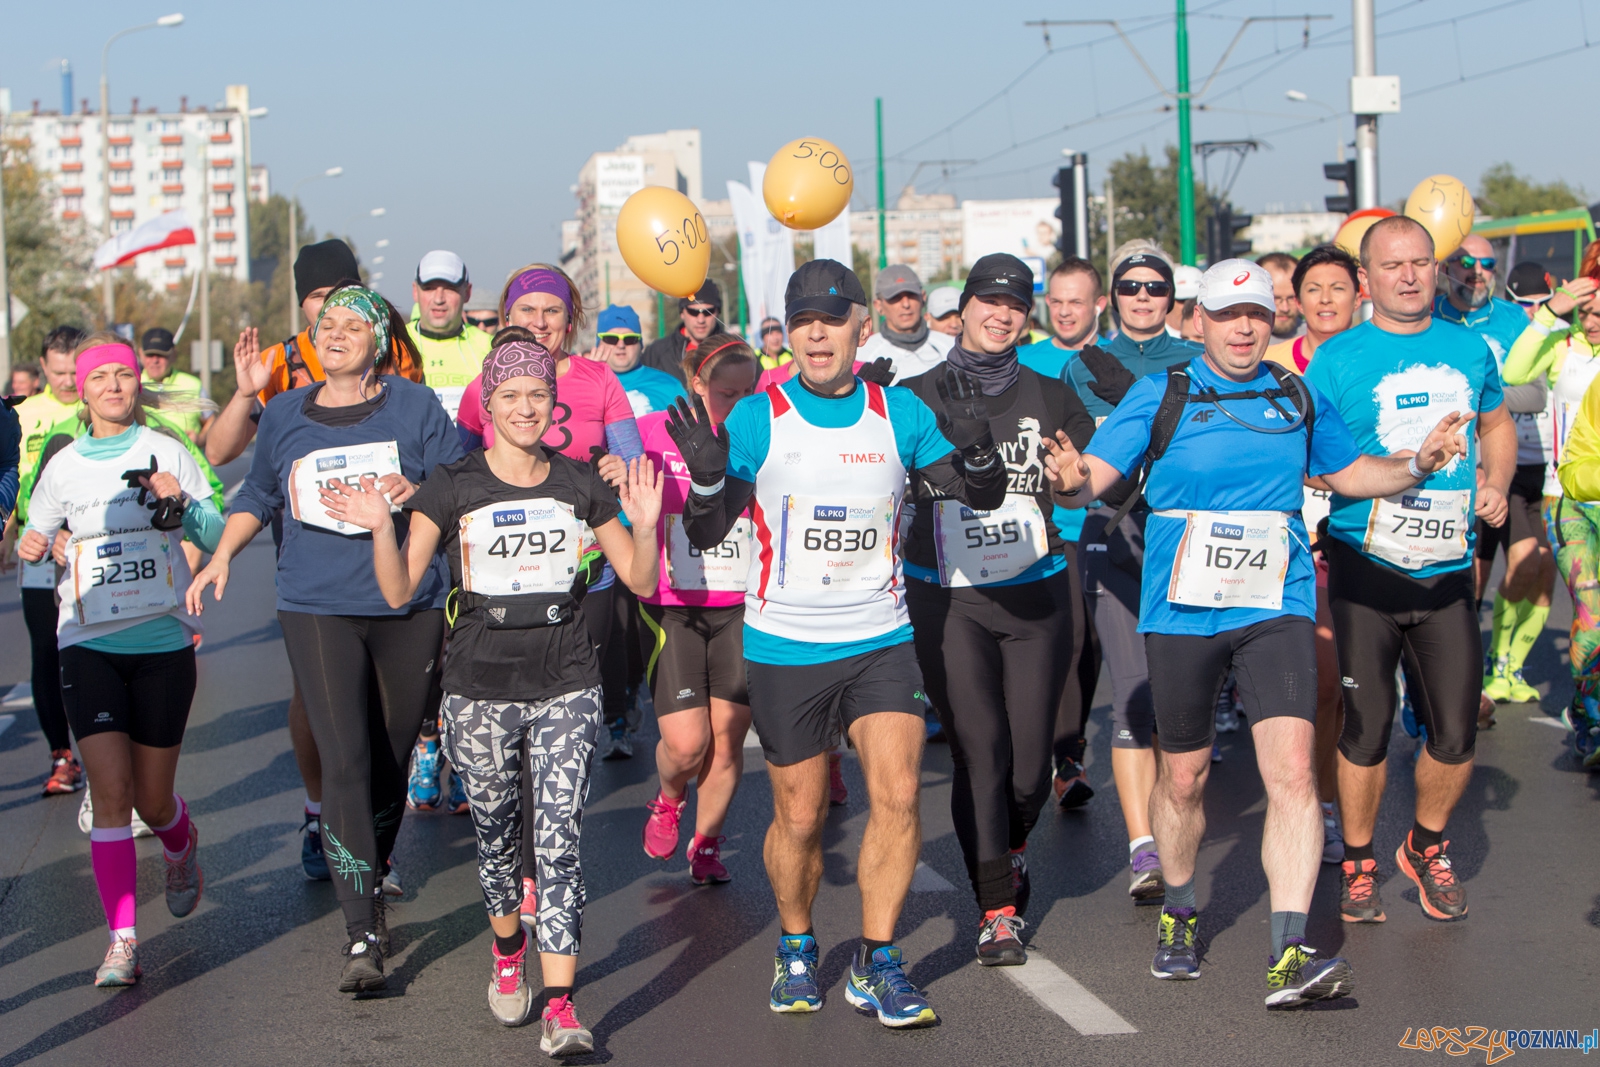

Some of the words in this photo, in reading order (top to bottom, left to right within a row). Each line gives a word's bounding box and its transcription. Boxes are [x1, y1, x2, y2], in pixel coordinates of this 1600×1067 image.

[793, 141, 850, 186] 5:00
[655, 212, 708, 266] 5:00
[1191, 409, 1217, 423] 4F
[839, 453, 887, 464] TIMEX
[1391, 514, 1456, 540] 7396
[488, 529, 566, 559] 4792
[804, 528, 878, 553] 6830
[827, 560, 854, 568] Dariusz
[982, 552, 1009, 561] Joanna
[1205, 544, 1268, 571] 1674
[92, 559, 157, 588] 3238
[111, 589, 140, 598] Karolina
